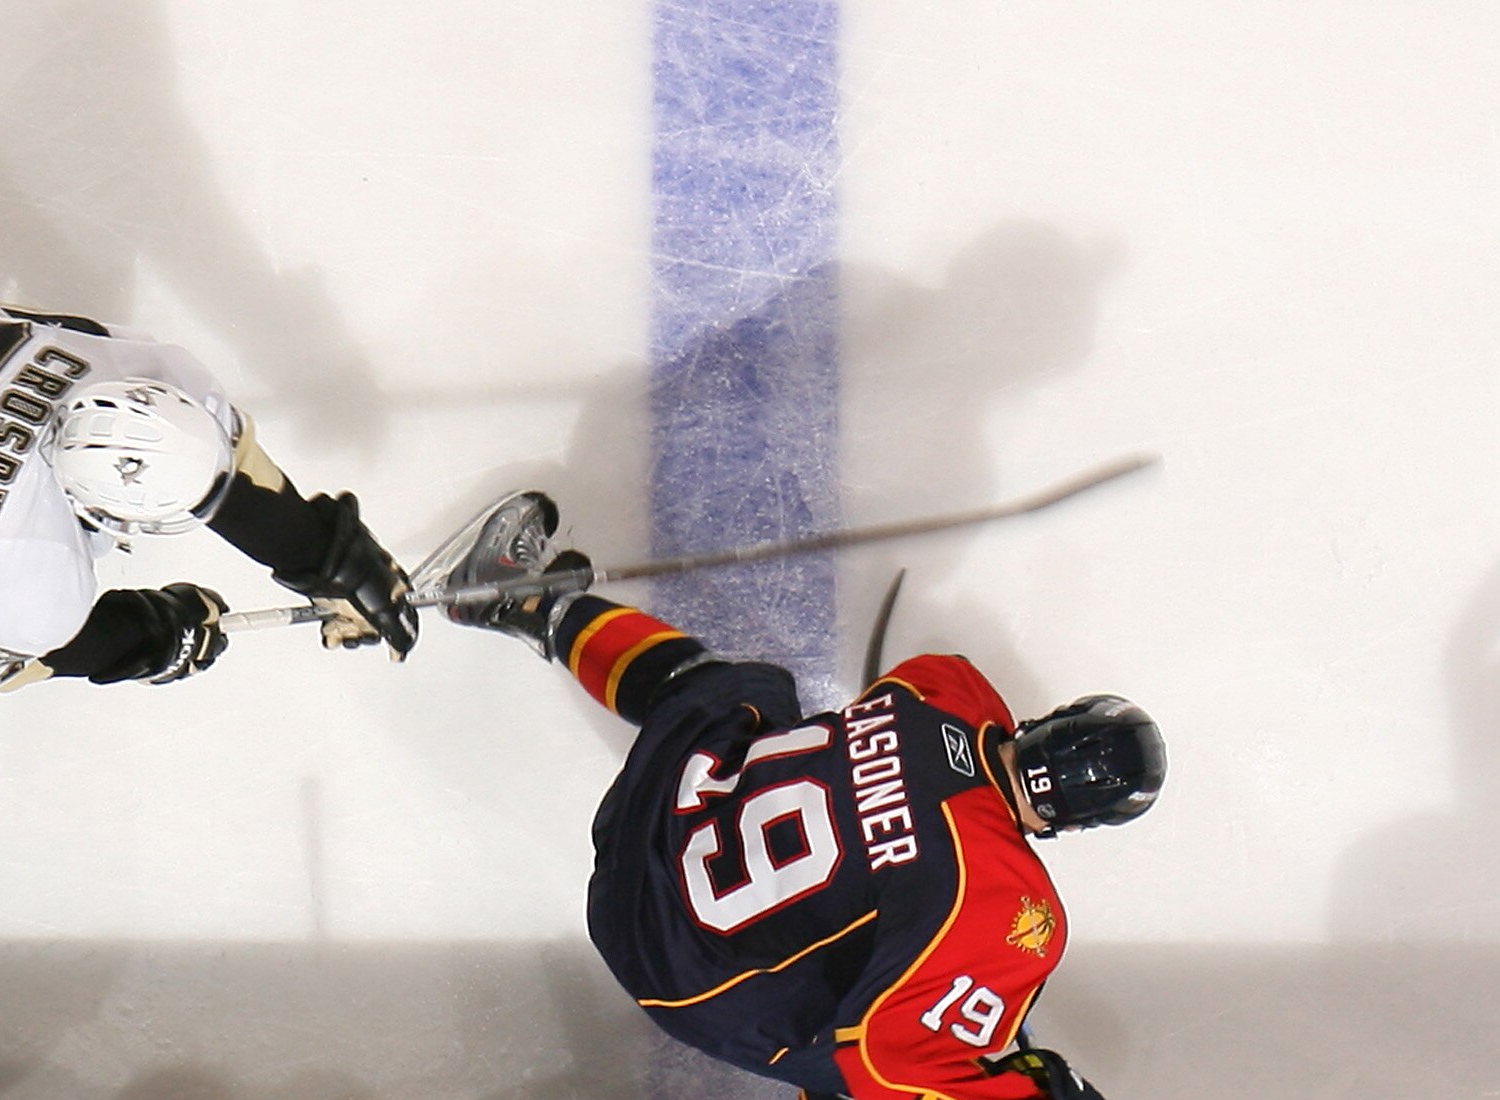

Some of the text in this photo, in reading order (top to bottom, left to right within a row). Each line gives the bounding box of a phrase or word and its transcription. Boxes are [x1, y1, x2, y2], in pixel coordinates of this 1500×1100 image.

[1026, 765, 1053, 795] 19
[673, 725, 846, 936] 19
[919, 974, 1006, 1048] 19
